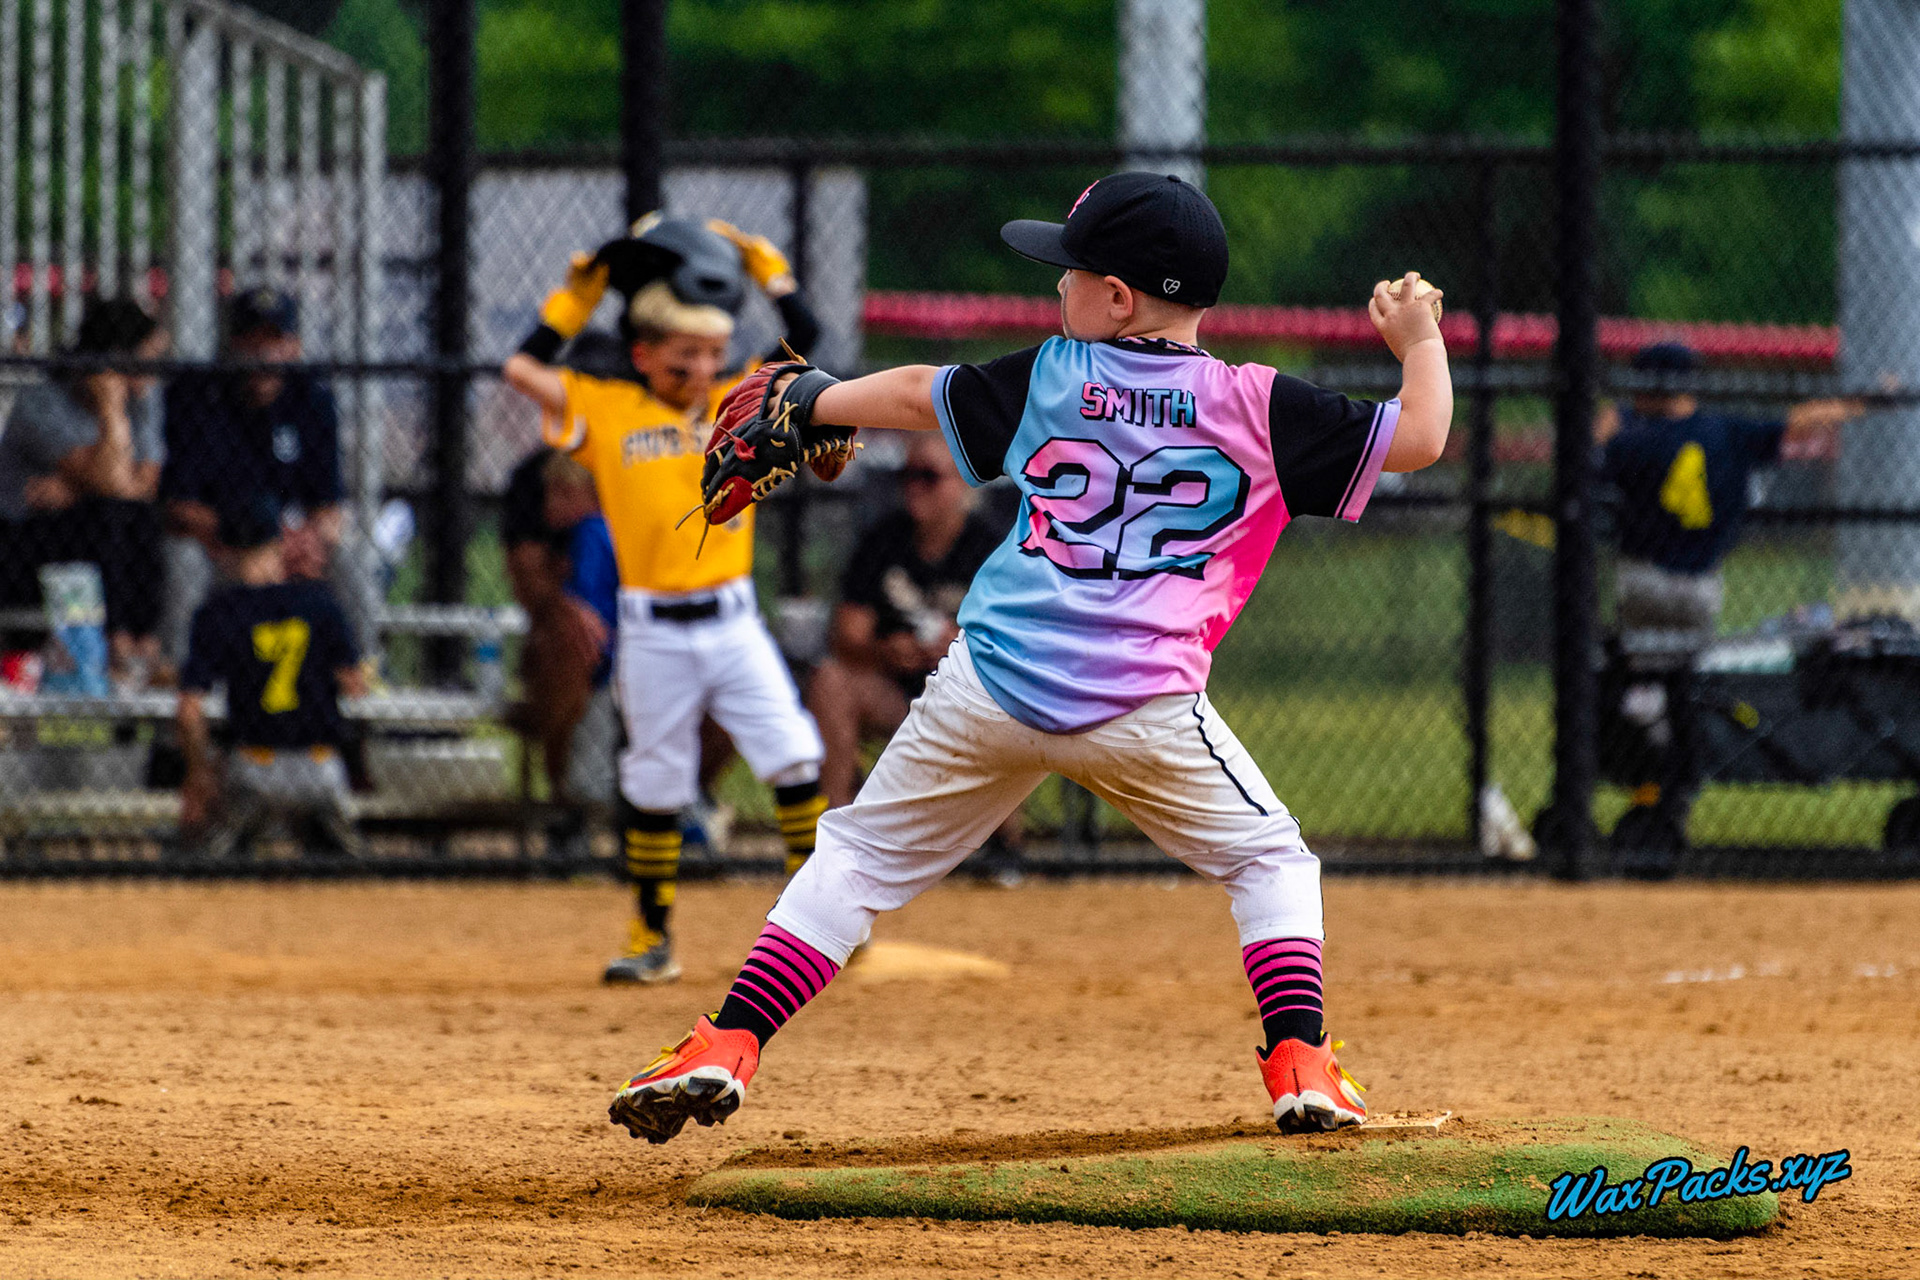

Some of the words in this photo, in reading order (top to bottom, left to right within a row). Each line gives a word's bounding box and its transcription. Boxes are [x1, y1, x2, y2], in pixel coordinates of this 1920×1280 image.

[1080, 381, 1197, 428] SMITH
[1019, 437, 1252, 581] 22
[1660, 442, 1713, 530] 4
[252, 617, 311, 714] 7
